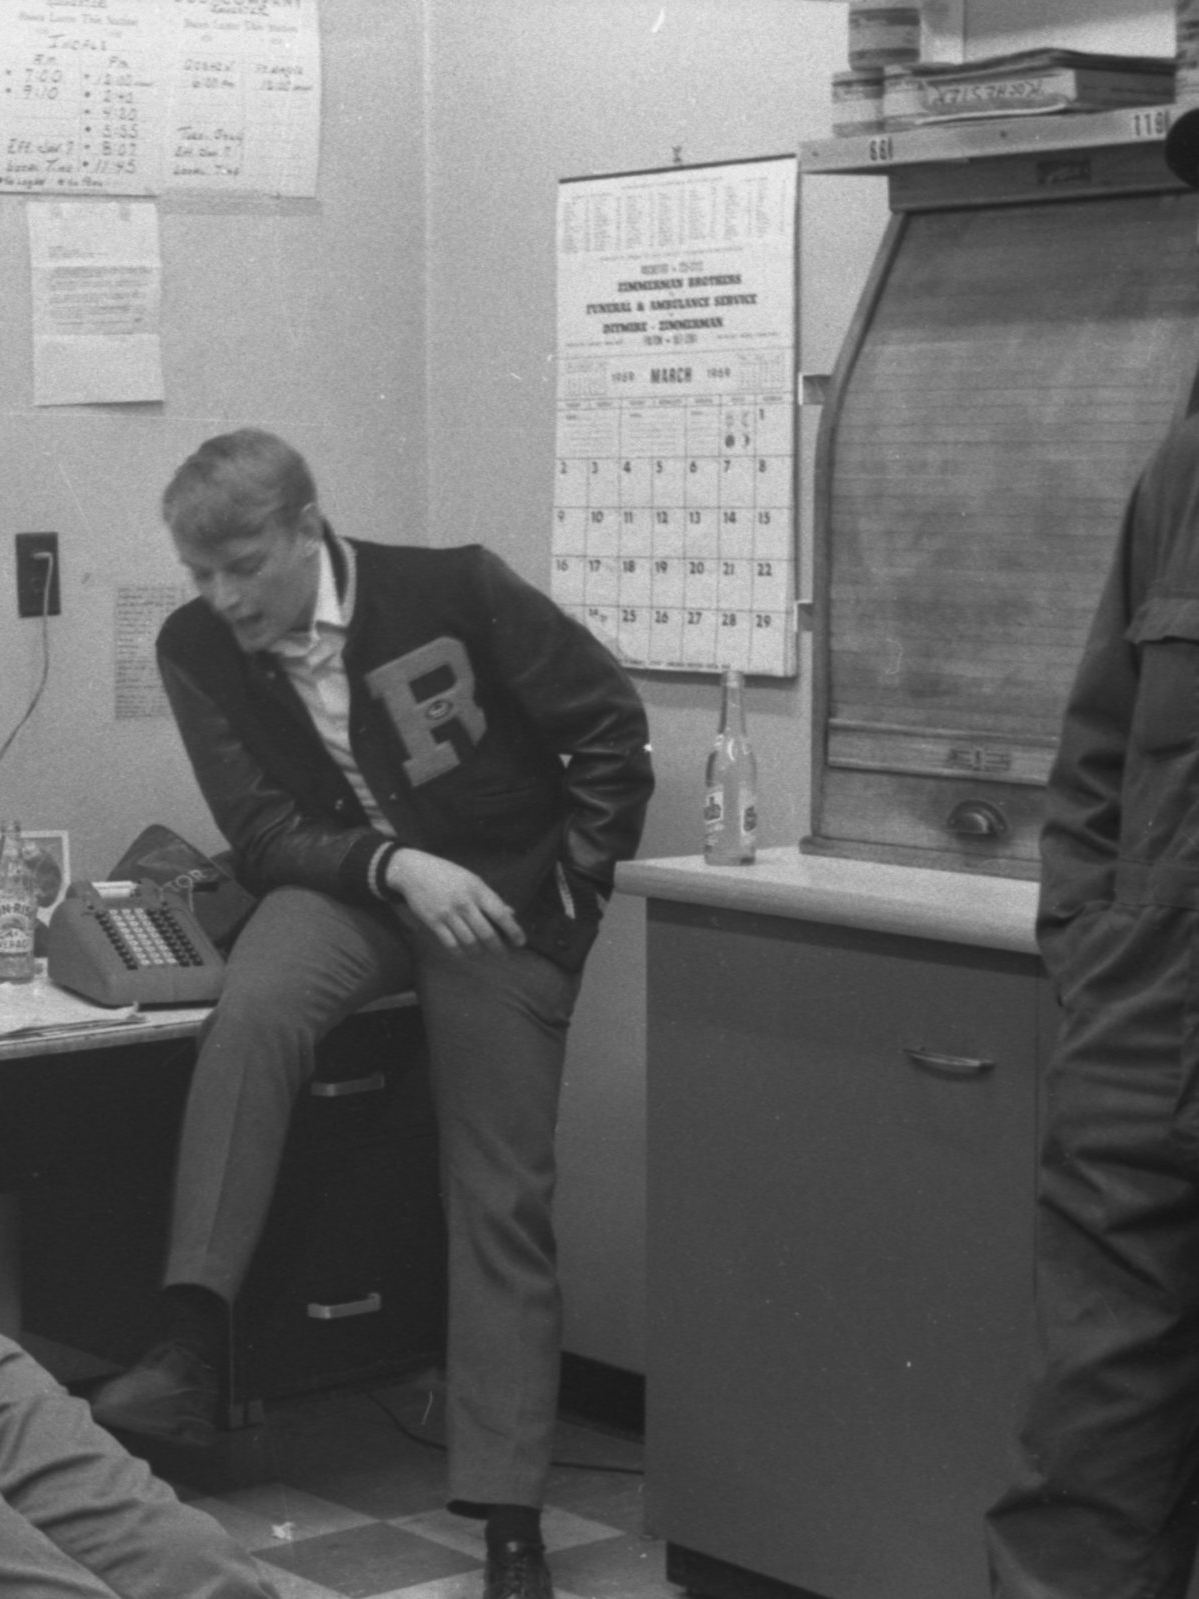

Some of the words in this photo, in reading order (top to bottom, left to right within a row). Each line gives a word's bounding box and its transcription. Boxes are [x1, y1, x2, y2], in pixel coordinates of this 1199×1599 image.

[617, 278, 683, 293] ZIMMERMAN
[688, 273, 742, 288] BROTHERS
[586, 301, 632, 315] FUNERAL
[714, 293, 758, 307] SERVICE
[651, 366, 693, 384] MARCH
[758, 407, 766, 421] 1
[559, 460, 568, 475] 2
[591, 460, 599, 475] 3
[623, 460, 632, 474] 4
[656, 460, 664, 474] 5
[689, 460, 698, 474] 6
[723, 459, 732, 473] 7
[758, 458, 767, 473] 8
[557, 509, 565, 522] 9
[591, 510, 604, 524] 10
[623, 510, 634, 525] 11
[656, 511, 669, 525] 12
[689, 510, 702, 525] 13
[723, 511, 737, 525] 14
[758, 511, 771, 525] 15
[556, 559, 568, 572] 16
[589, 559, 601, 573] 17
[622, 559, 636, 573] 18
[655, 560, 668, 574] 19
[689, 560, 705, 575] 20
[722, 561, 735, 576] 21
[757, 562, 773, 577] 22
[622, 609, 636, 624] 25
[654, 610, 669, 625] 26
[687, 611, 702, 625] 27
[721, 612, 737, 627] 28
[755, 613, 771, 628] 29
[365, 636, 488, 788] R
